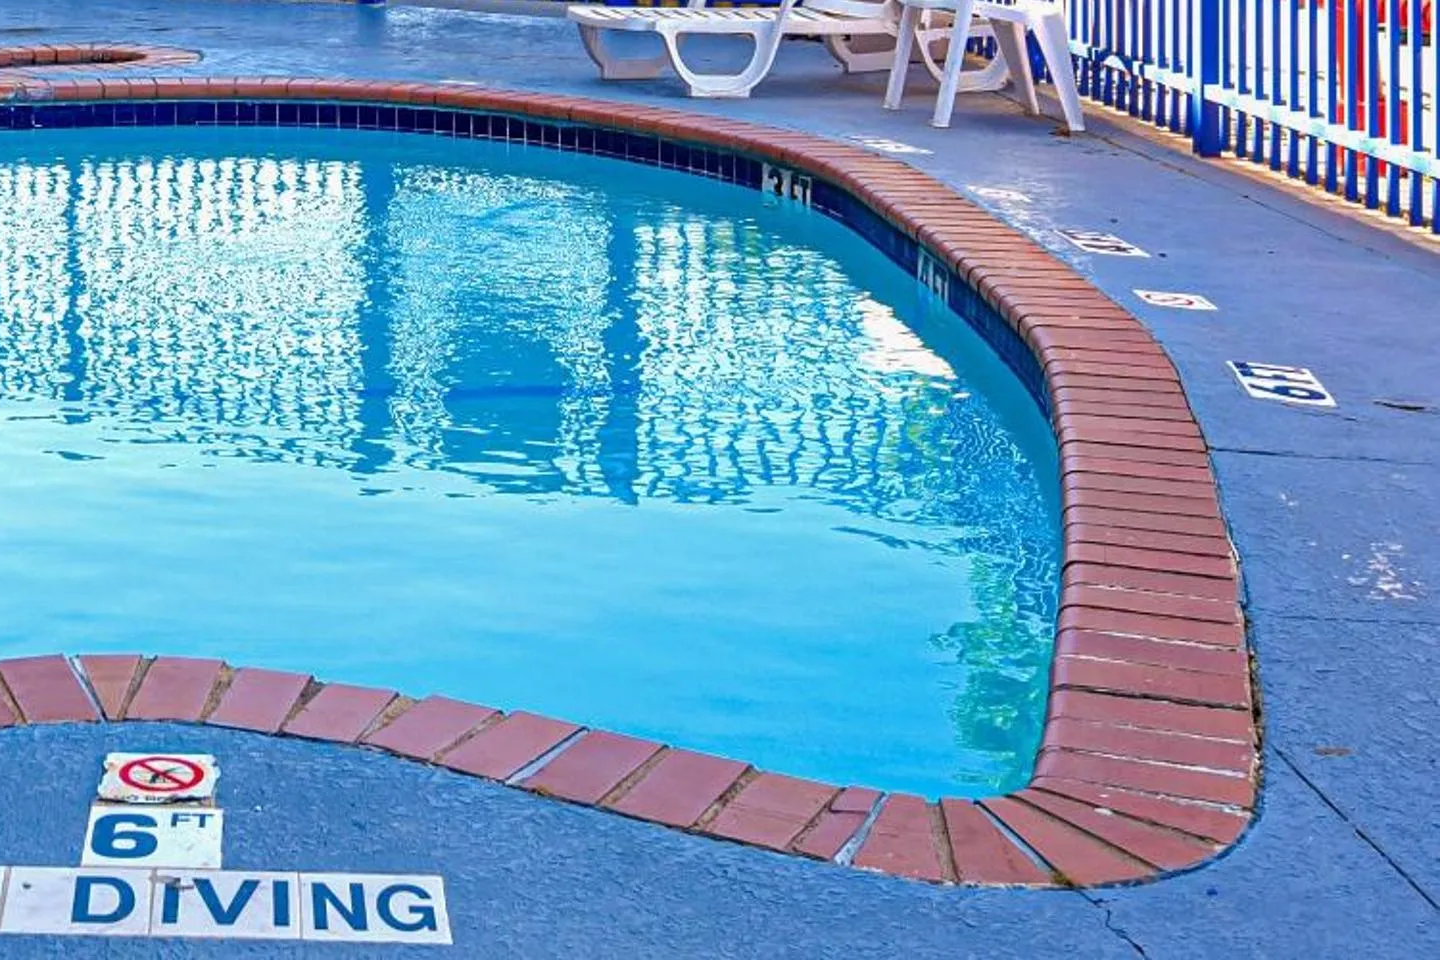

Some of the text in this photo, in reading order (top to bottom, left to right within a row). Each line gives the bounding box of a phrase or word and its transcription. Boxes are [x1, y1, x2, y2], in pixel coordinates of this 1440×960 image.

[91, 813, 215, 859] 6 FT
[71, 875, 438, 932] DIVING
